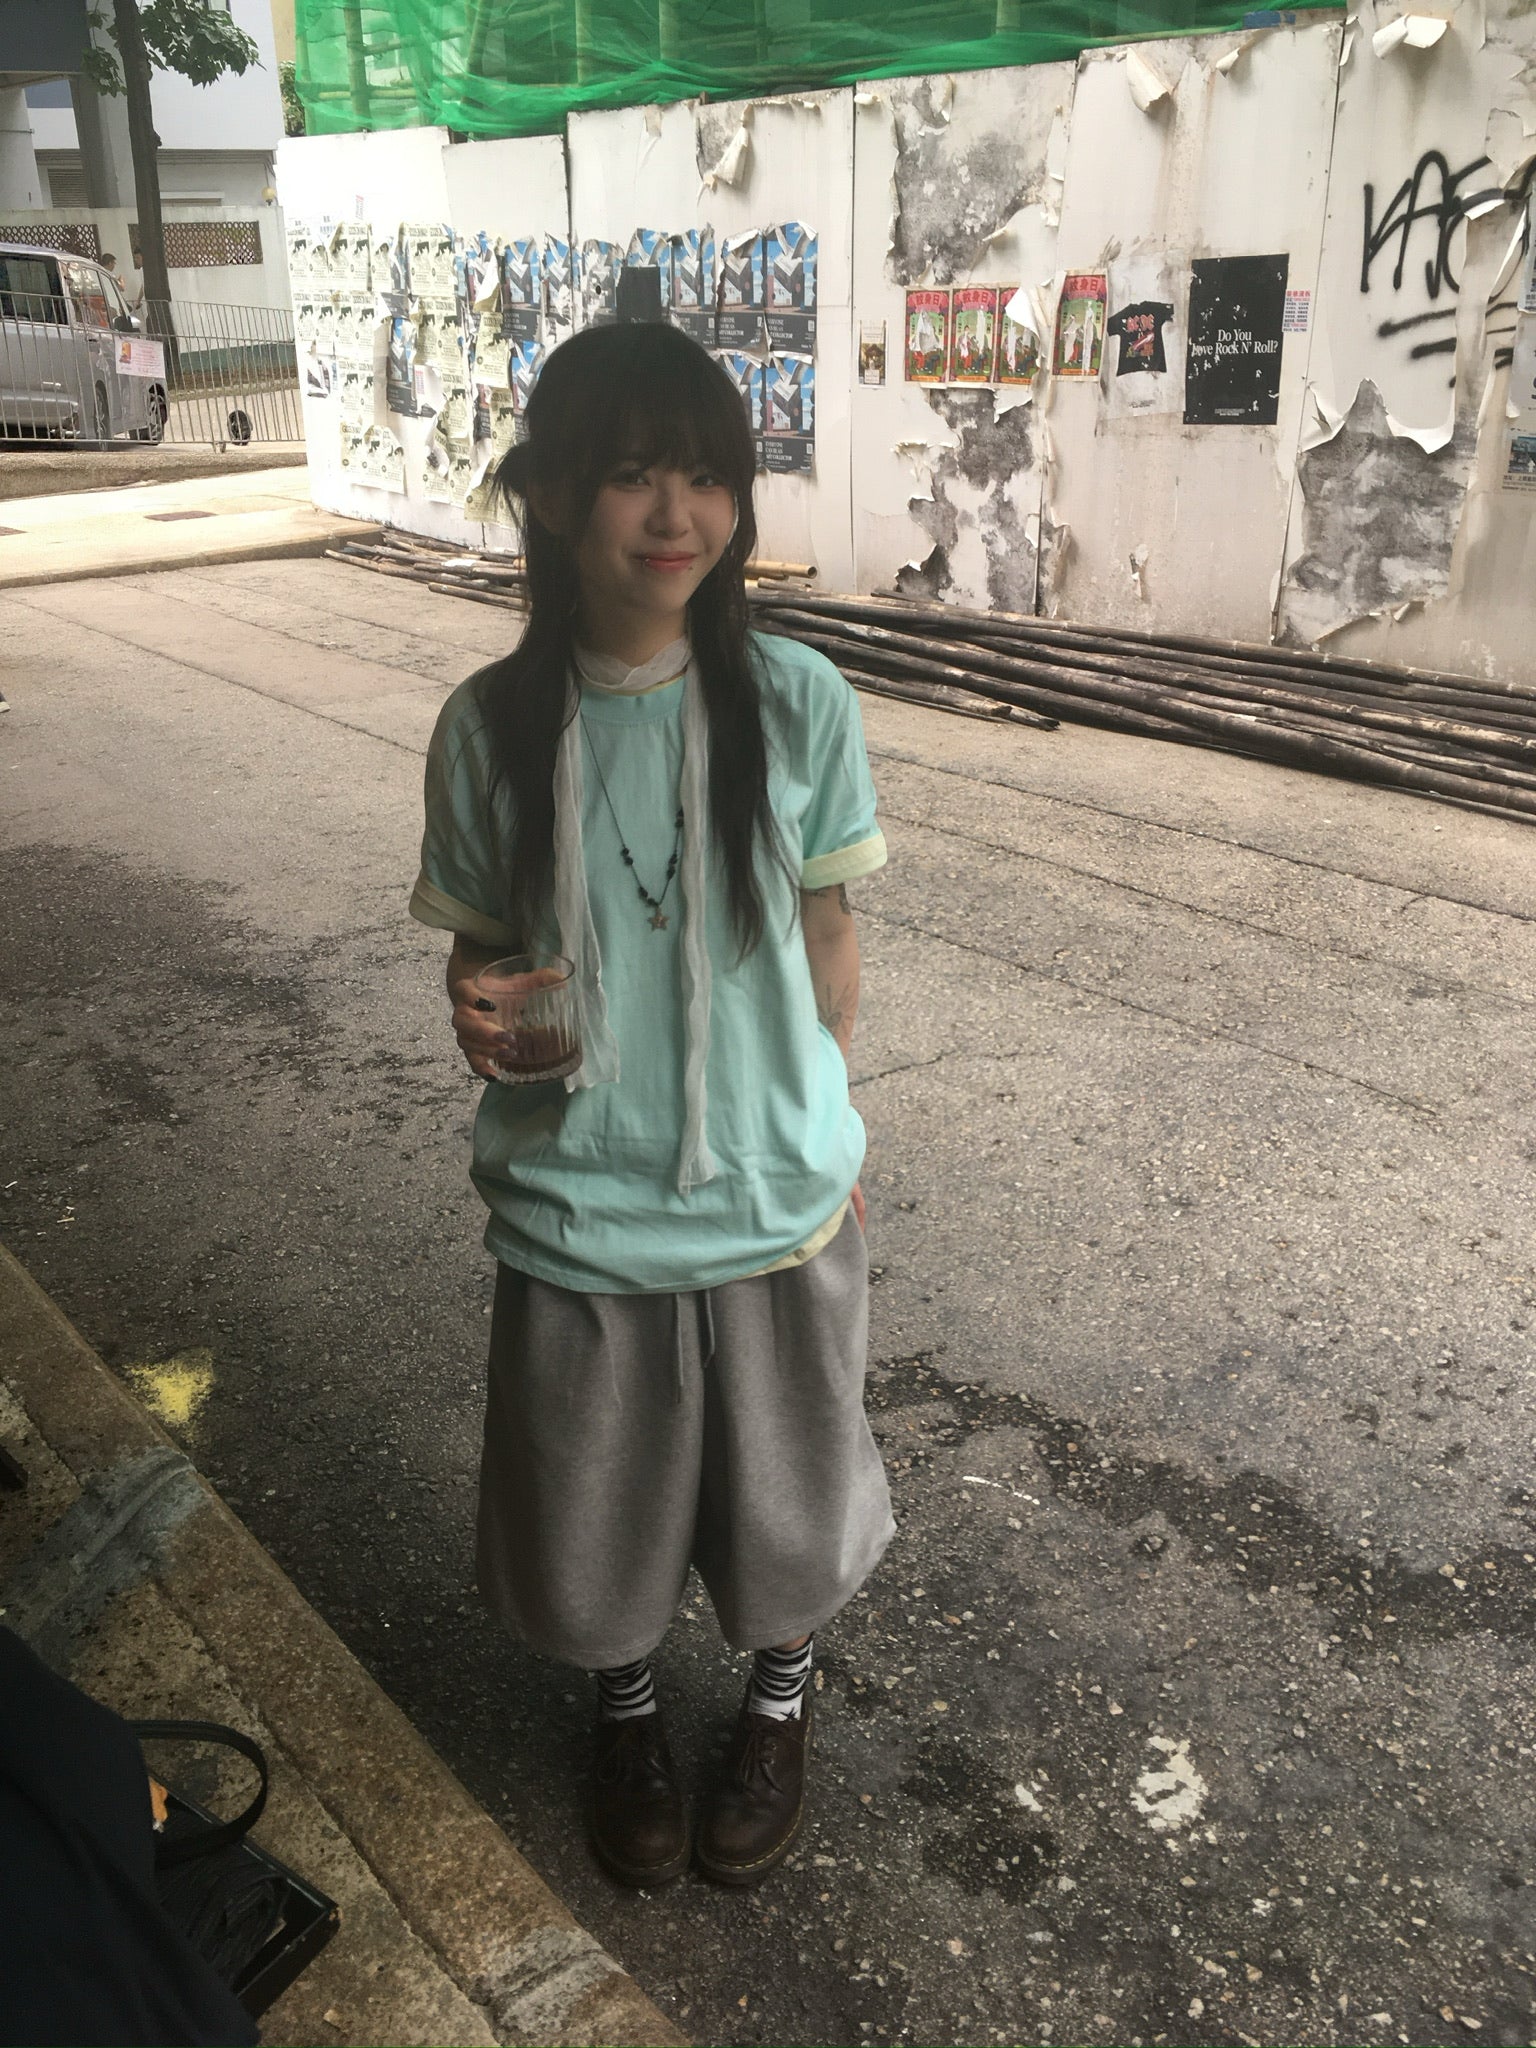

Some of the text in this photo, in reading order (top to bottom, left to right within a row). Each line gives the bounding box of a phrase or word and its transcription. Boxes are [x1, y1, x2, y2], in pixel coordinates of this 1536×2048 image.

[1218, 328, 1252, 342] Do You
[1215, 341, 1239, 355] Rock
[1253, 339, 1279, 354] Roll?
